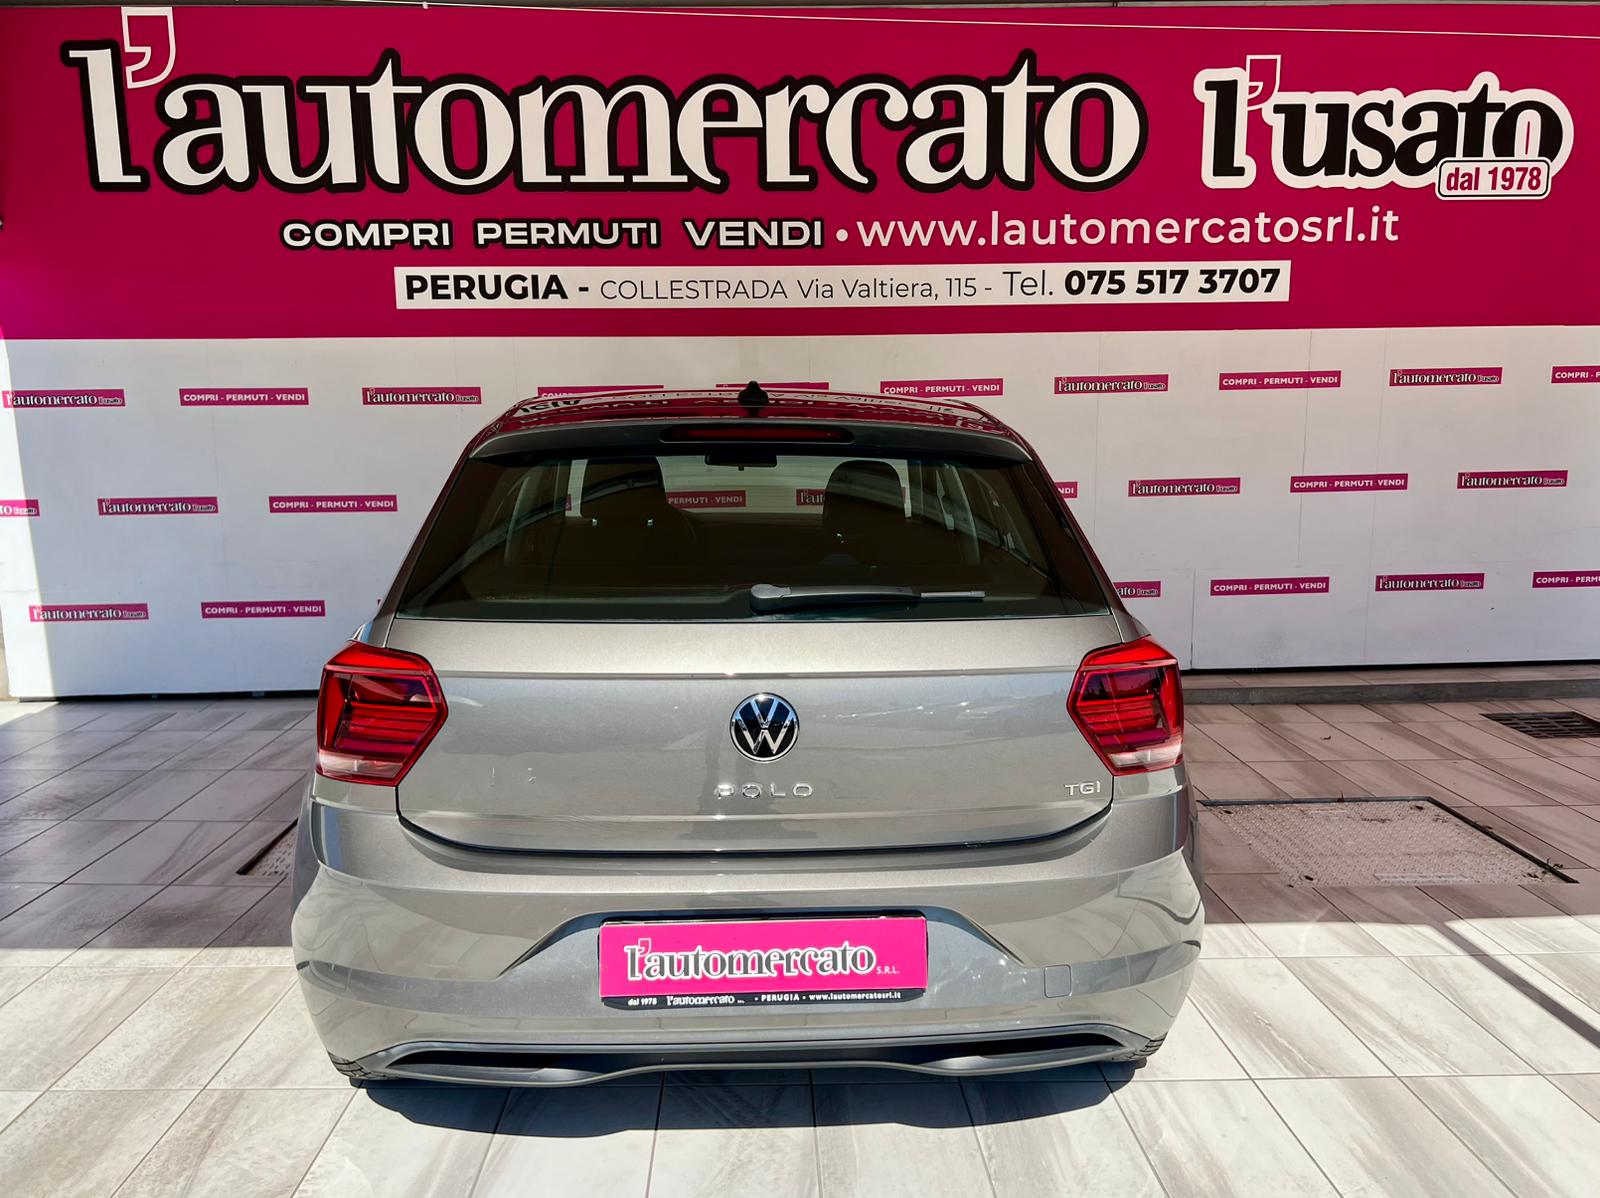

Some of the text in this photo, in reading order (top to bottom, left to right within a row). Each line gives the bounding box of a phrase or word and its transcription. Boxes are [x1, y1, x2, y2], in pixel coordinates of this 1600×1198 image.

[62, 7, 1147, 191] l'automercato
[1446, 167, 1541, 191] dal 1978
[282, 207, 1399, 247] COMPRI PERMUTI VENDI www.lautomercatosrl.it
[405, 274, 568, 300] PERUGIA
[600, 280, 787, 300] COLLESTRADA
[797, 279, 834, 299] Via
[841, 278, 938, 300] Valtiera,
[945, 278, 977, 297] 115
[1002, 270, 1053, 297] Tel.
[1064, 270, 1126, 296] 075
[1136, 269, 1189, 296] 517
[1199, 268, 1281, 294] 3707
[1554, 371, 1589, 379] COMPRI
[1222, 376, 1338, 386] COMPRI PERMUTI VENDI
[883, 384, 1000, 394] COMPRI PERMUTI VENDI
[183, 393, 305, 401] COMPRI PERMUTI VENDI
[1293, 479, 1405, 489] COMPRI PERMUTI VENDI
[272, 500, 394, 509] COMPRI PERMUTI VENDI
[1535, 576, 1569, 584] COMPRI
[1213, 582, 1326, 592] COMPRI PERMUTI VENDI
[204, 605, 322, 614] COMPRI PERMUTI VENDI
[714, 782, 813, 799] POLO
[1064, 780, 1101, 796] TGI
[624, 938, 900, 981] l'automercato S.R.L.
[761, 994, 800, 1002] PERUGIA
